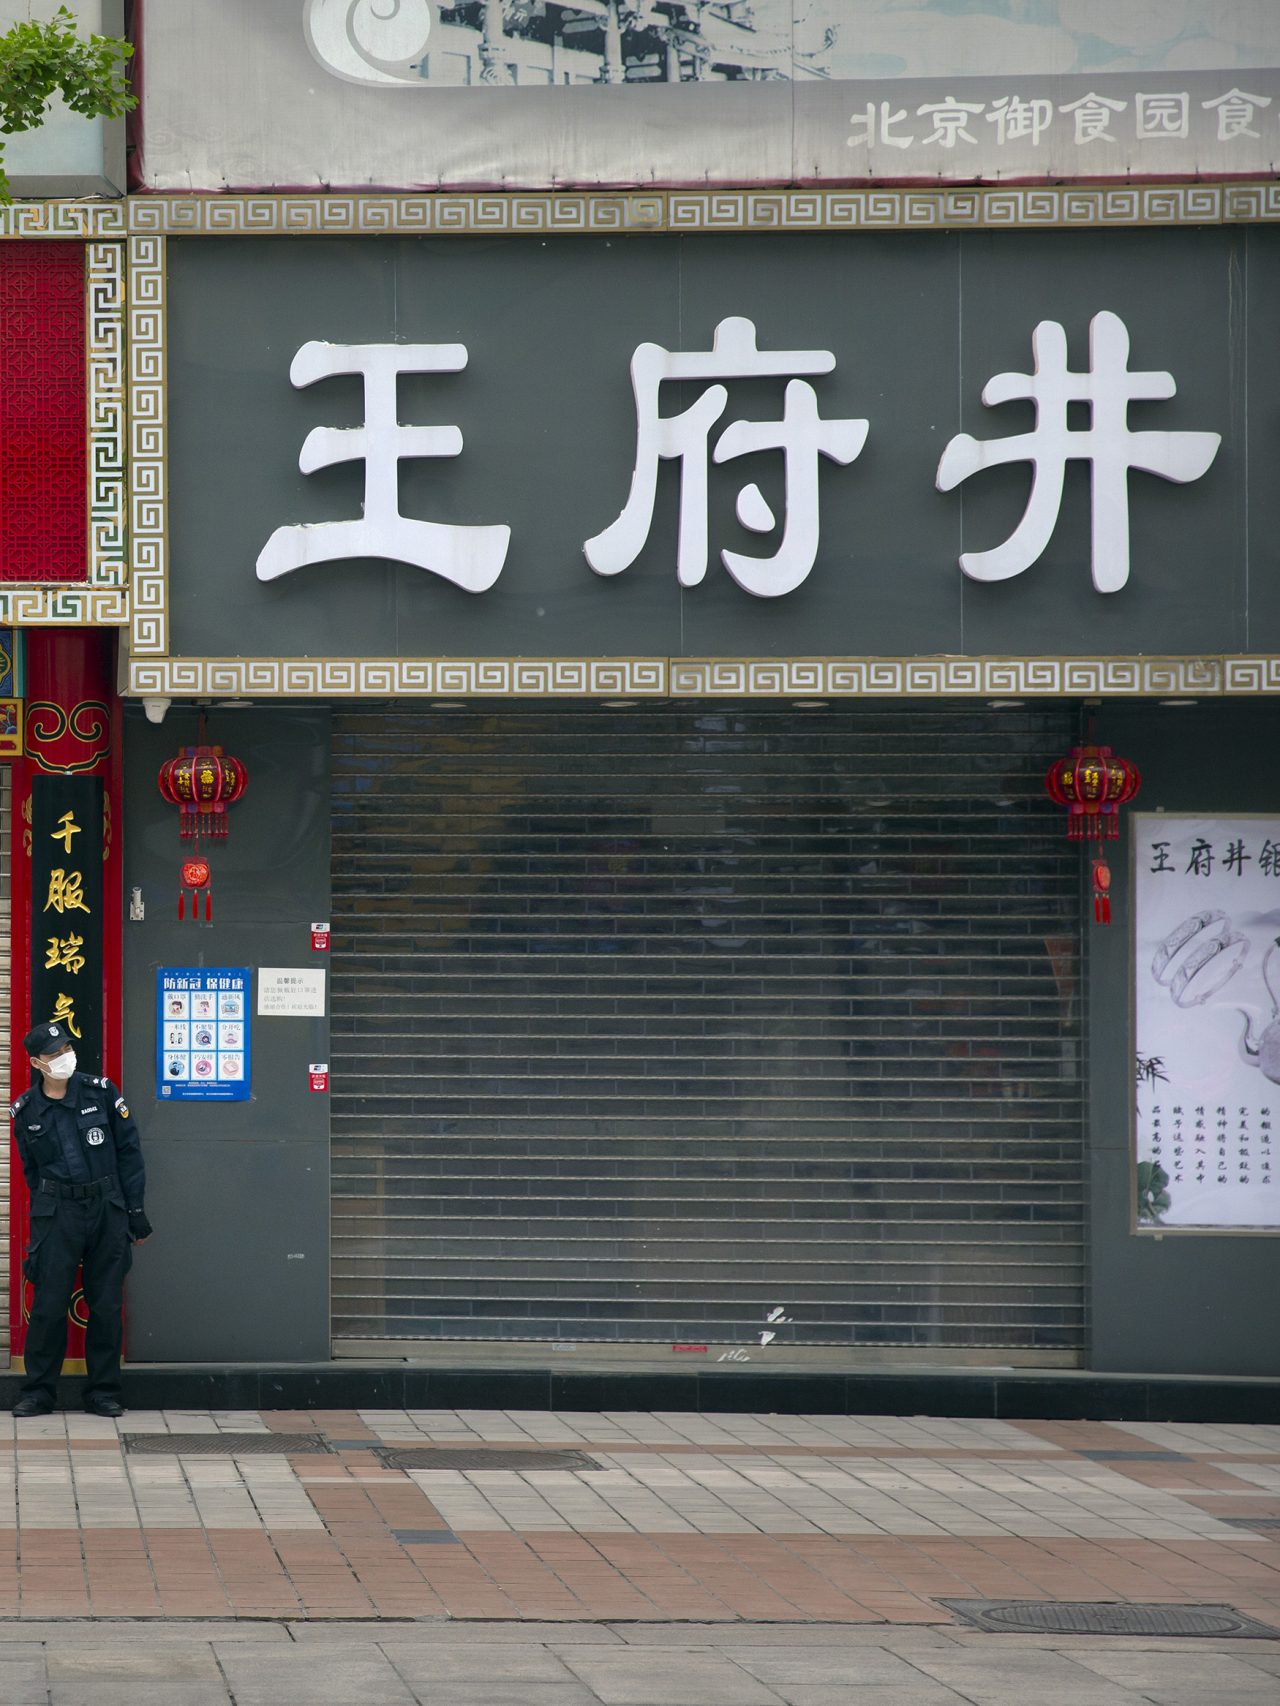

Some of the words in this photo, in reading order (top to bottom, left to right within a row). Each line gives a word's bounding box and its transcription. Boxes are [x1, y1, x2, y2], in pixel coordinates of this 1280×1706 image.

[255, 310, 1222, 598] 王府井
[163, 977, 201, 990] 防新冠
[206, 977, 244, 990] 保健康
